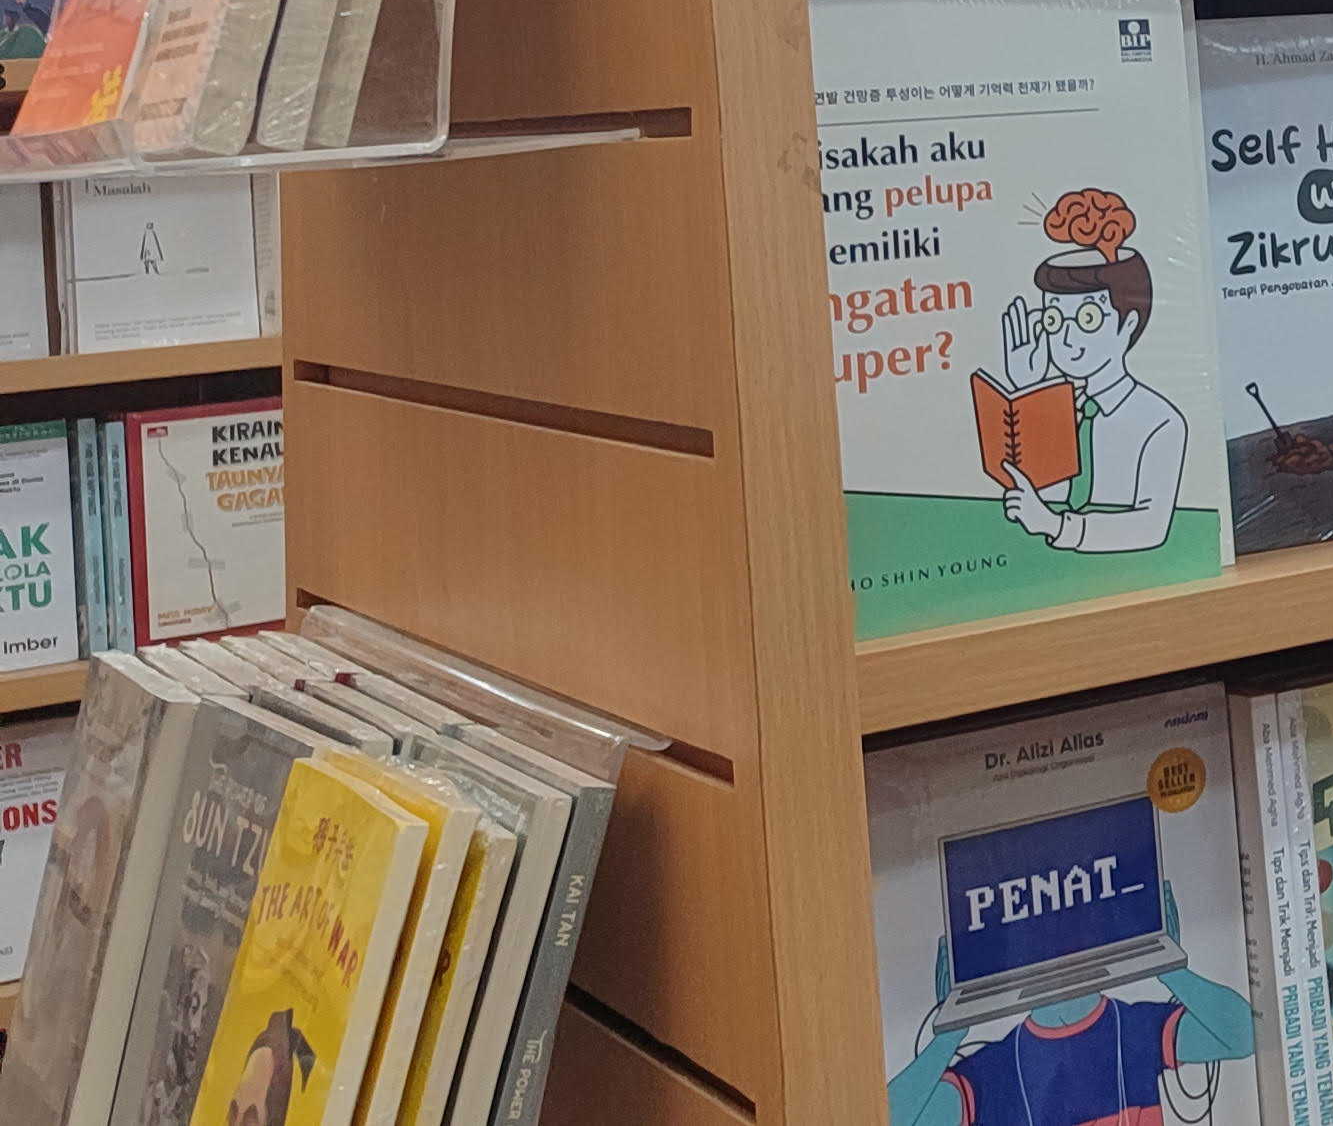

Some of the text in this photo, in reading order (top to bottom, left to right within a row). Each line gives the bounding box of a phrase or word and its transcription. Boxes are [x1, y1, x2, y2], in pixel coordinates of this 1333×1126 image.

[1119, 33, 1152, 50] BIP
[1255, 52, 1271, 67] H.
[1272, 51, 1317, 67] Ahmad
[818, 131, 986, 170] isakah aku
[1211, 124, 1302, 173] Self
[885, 175, 993, 217] pelupa
[829, 278, 973, 334] ngatan
[1222, 284, 1258, 300] Terapi
[1260, 277, 1329, 295] Pengobatan
[835, 330, 954, 394] uper?
[881, 553, 1009, 588] SHIN YOUNG
[984, 751, 1011, 771] Dr.
[1162, 762, 1190, 778] BEST
[552, 874, 586, 948] KAI TAN
[256, 882, 290, 926] THE
[290, 886, 324, 930] ART
[326, 925, 359, 989] WAR
